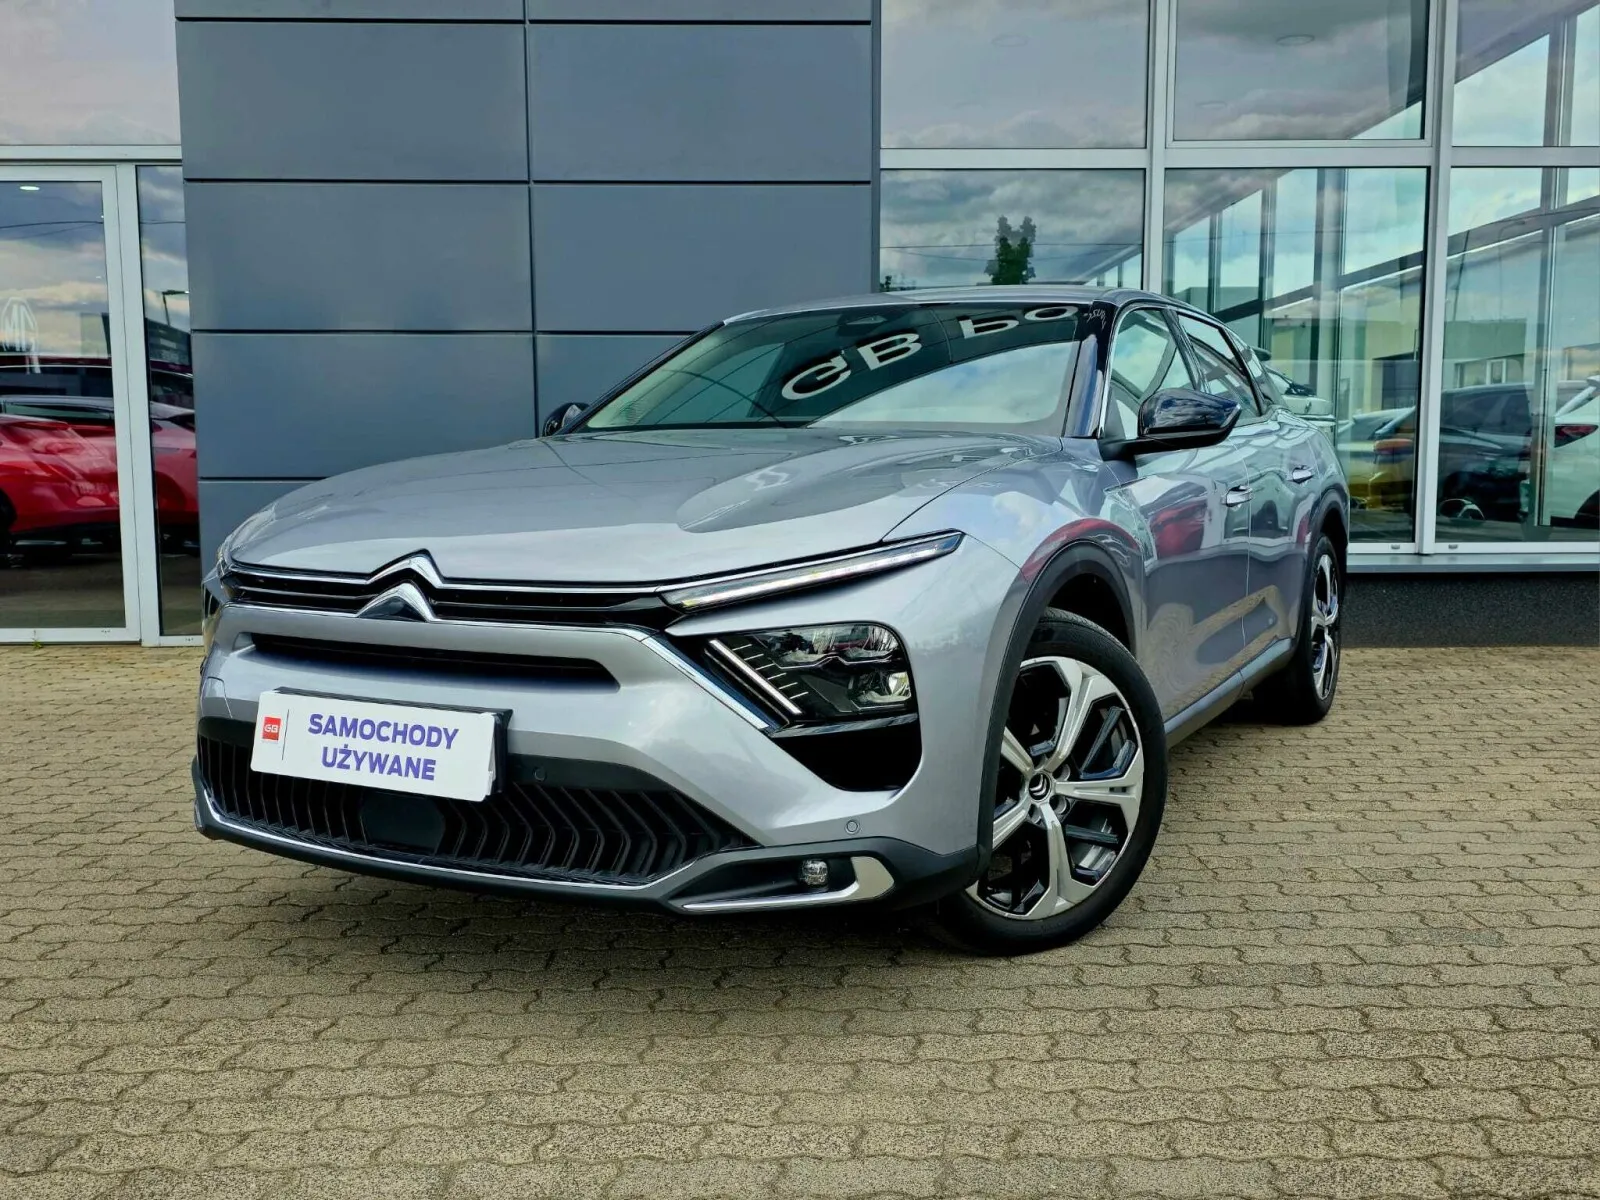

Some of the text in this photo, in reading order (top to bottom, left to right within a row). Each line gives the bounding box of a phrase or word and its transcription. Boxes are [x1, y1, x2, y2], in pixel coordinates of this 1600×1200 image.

[264, 724, 279, 734] GB
[307, 713, 459, 750] SAMOCHODY
[321, 744, 436, 781] UŻYWANE
